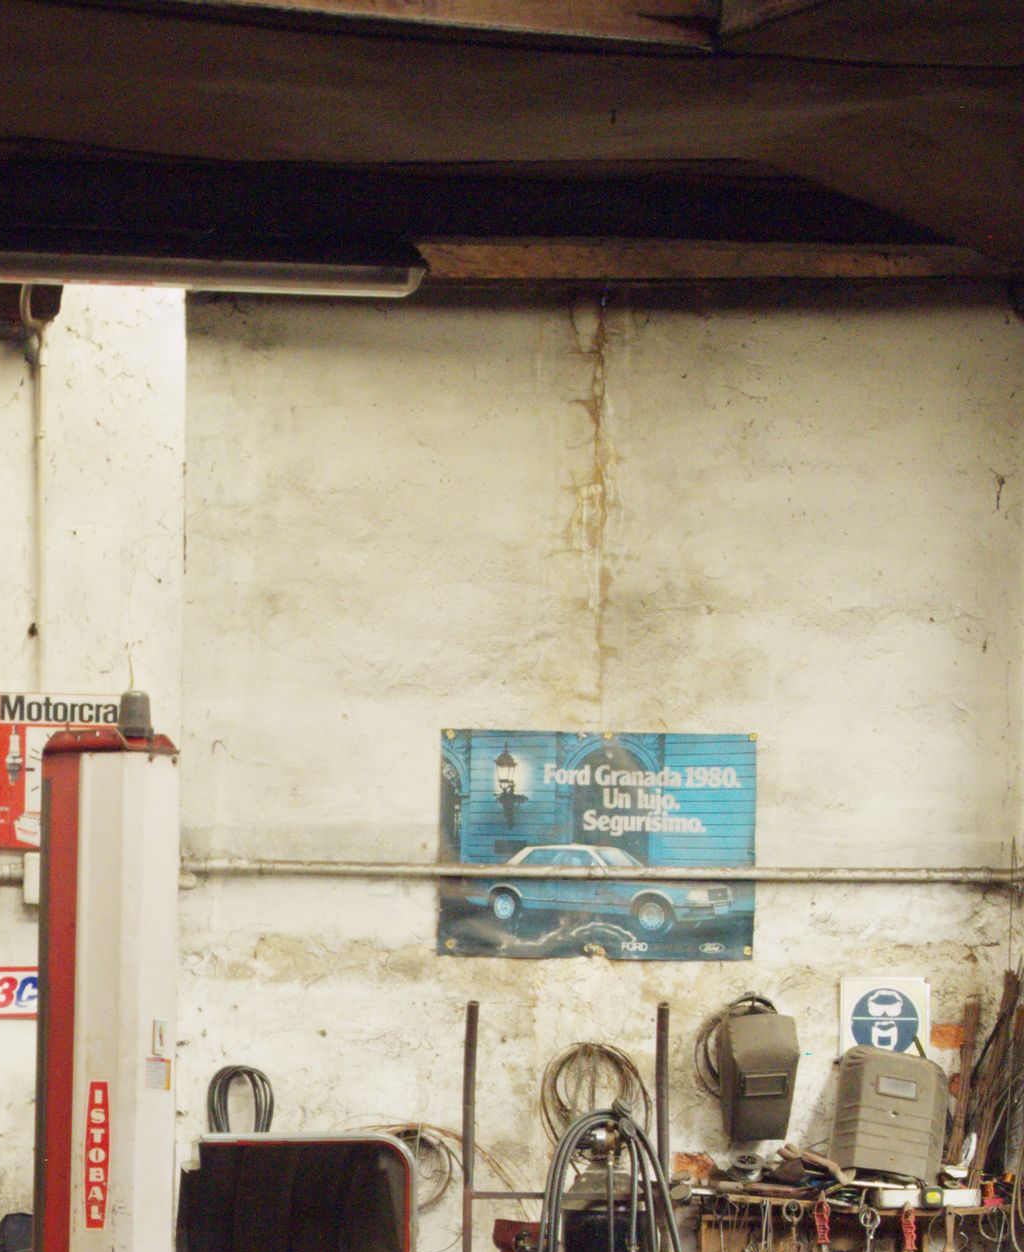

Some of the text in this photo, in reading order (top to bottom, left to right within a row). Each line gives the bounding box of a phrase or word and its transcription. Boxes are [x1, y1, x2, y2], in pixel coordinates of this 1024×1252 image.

[0, 695, 122, 724] Motorcra
[543, 763, 741, 789] Ford Granada 1980.
[603, 788, 680, 815] Un lujo.
[621, 942, 648, 952] FORD
[88, 1089, 106, 1220] ISTOBAL
